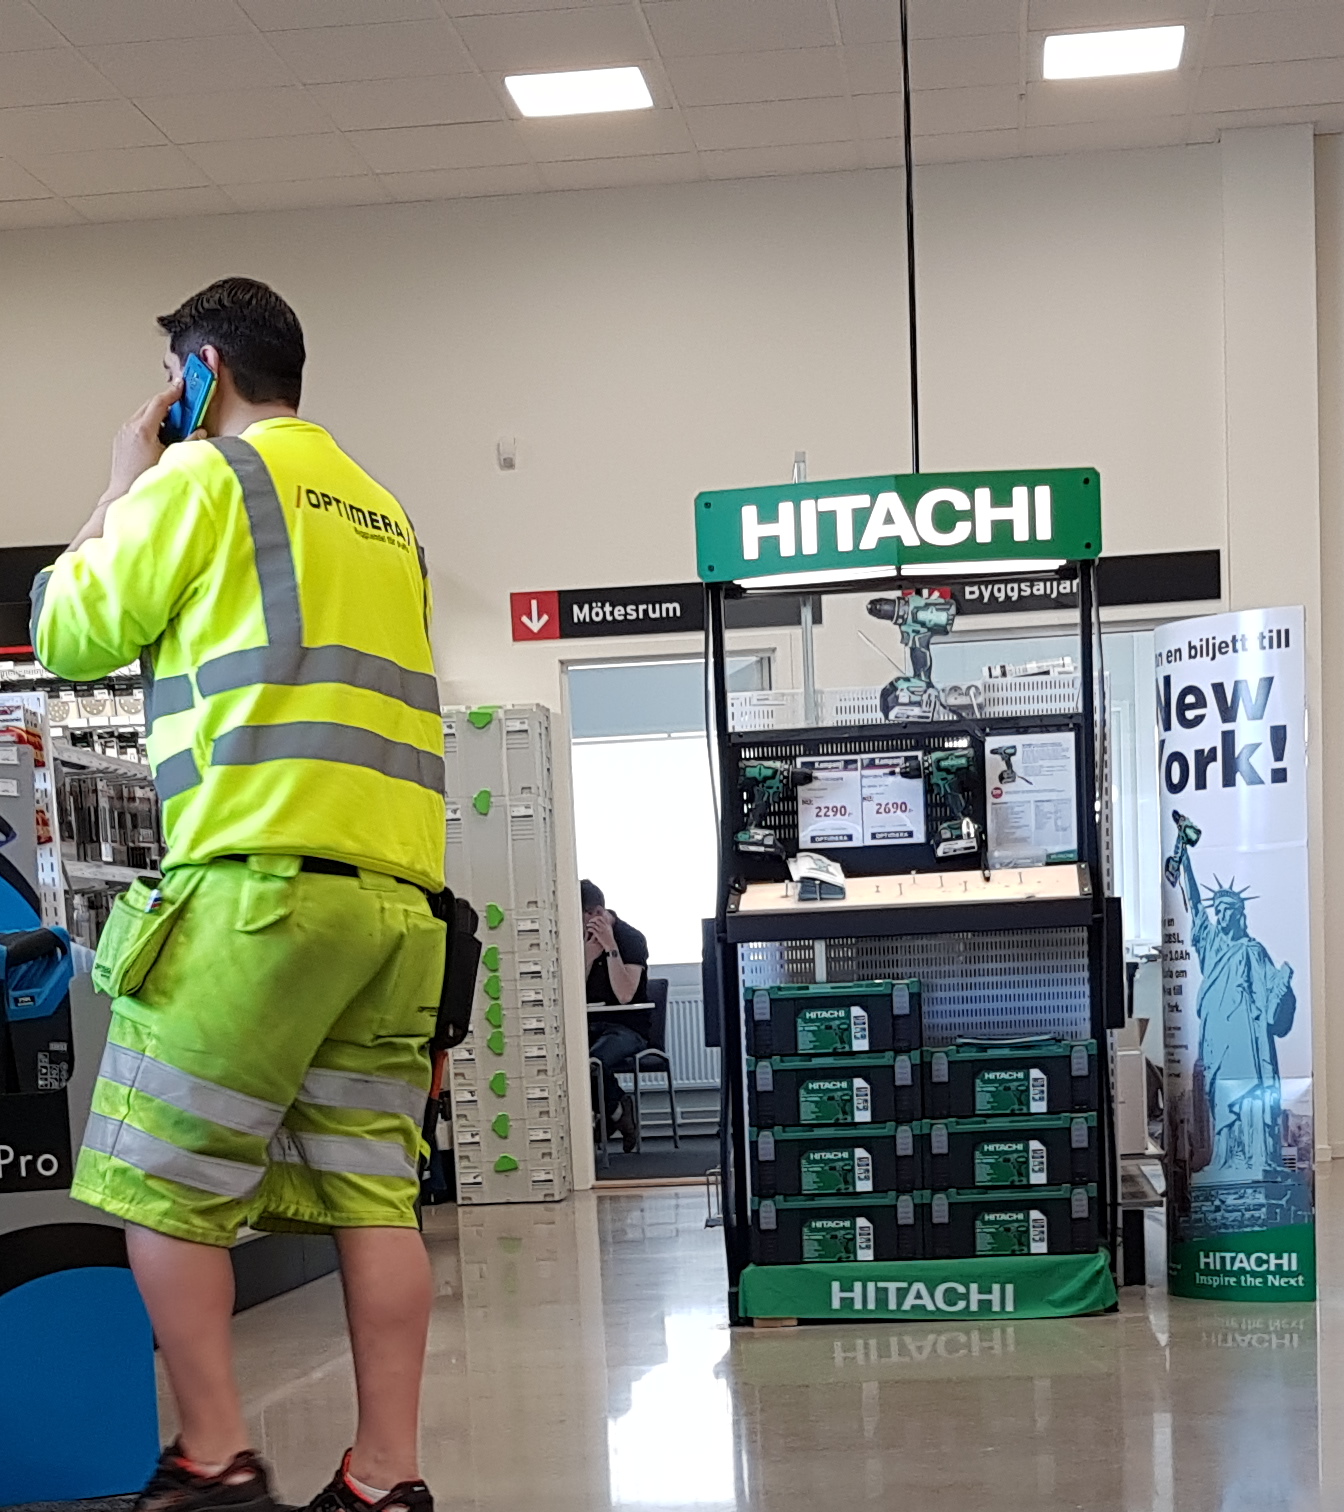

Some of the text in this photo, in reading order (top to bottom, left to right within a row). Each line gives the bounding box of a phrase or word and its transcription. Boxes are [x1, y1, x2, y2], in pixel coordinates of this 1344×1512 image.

[305, 488, 407, 542] OPTIMERA
[741, 484, 1052, 560] HITACHI
[572, 599, 682, 624] Mötesrum
[1166, 647, 1183, 664] en
[1187, 633, 1248, 662] biljett
[1258, 628, 1290, 650] till
[1156, 674, 1275, 733] New
[806, 1009, 845, 1020] HITACHI
[984, 1071, 1024, 1080] HITACHI
[808, 1080, 847, 1090] HITACHI
[983, 1143, 1024, 1152] HITACHI
[809, 1151, 849, 1161] HITACHI
[811, 1220, 851, 1229] HITACHI
[984, 1212, 1024, 1222] HITACHI
[1199, 1251, 1298, 1271] HITACHI
[1195, 1272, 1305, 1288] Inspire the Next
[830, 1280, 1015, 1312] HITACHI
